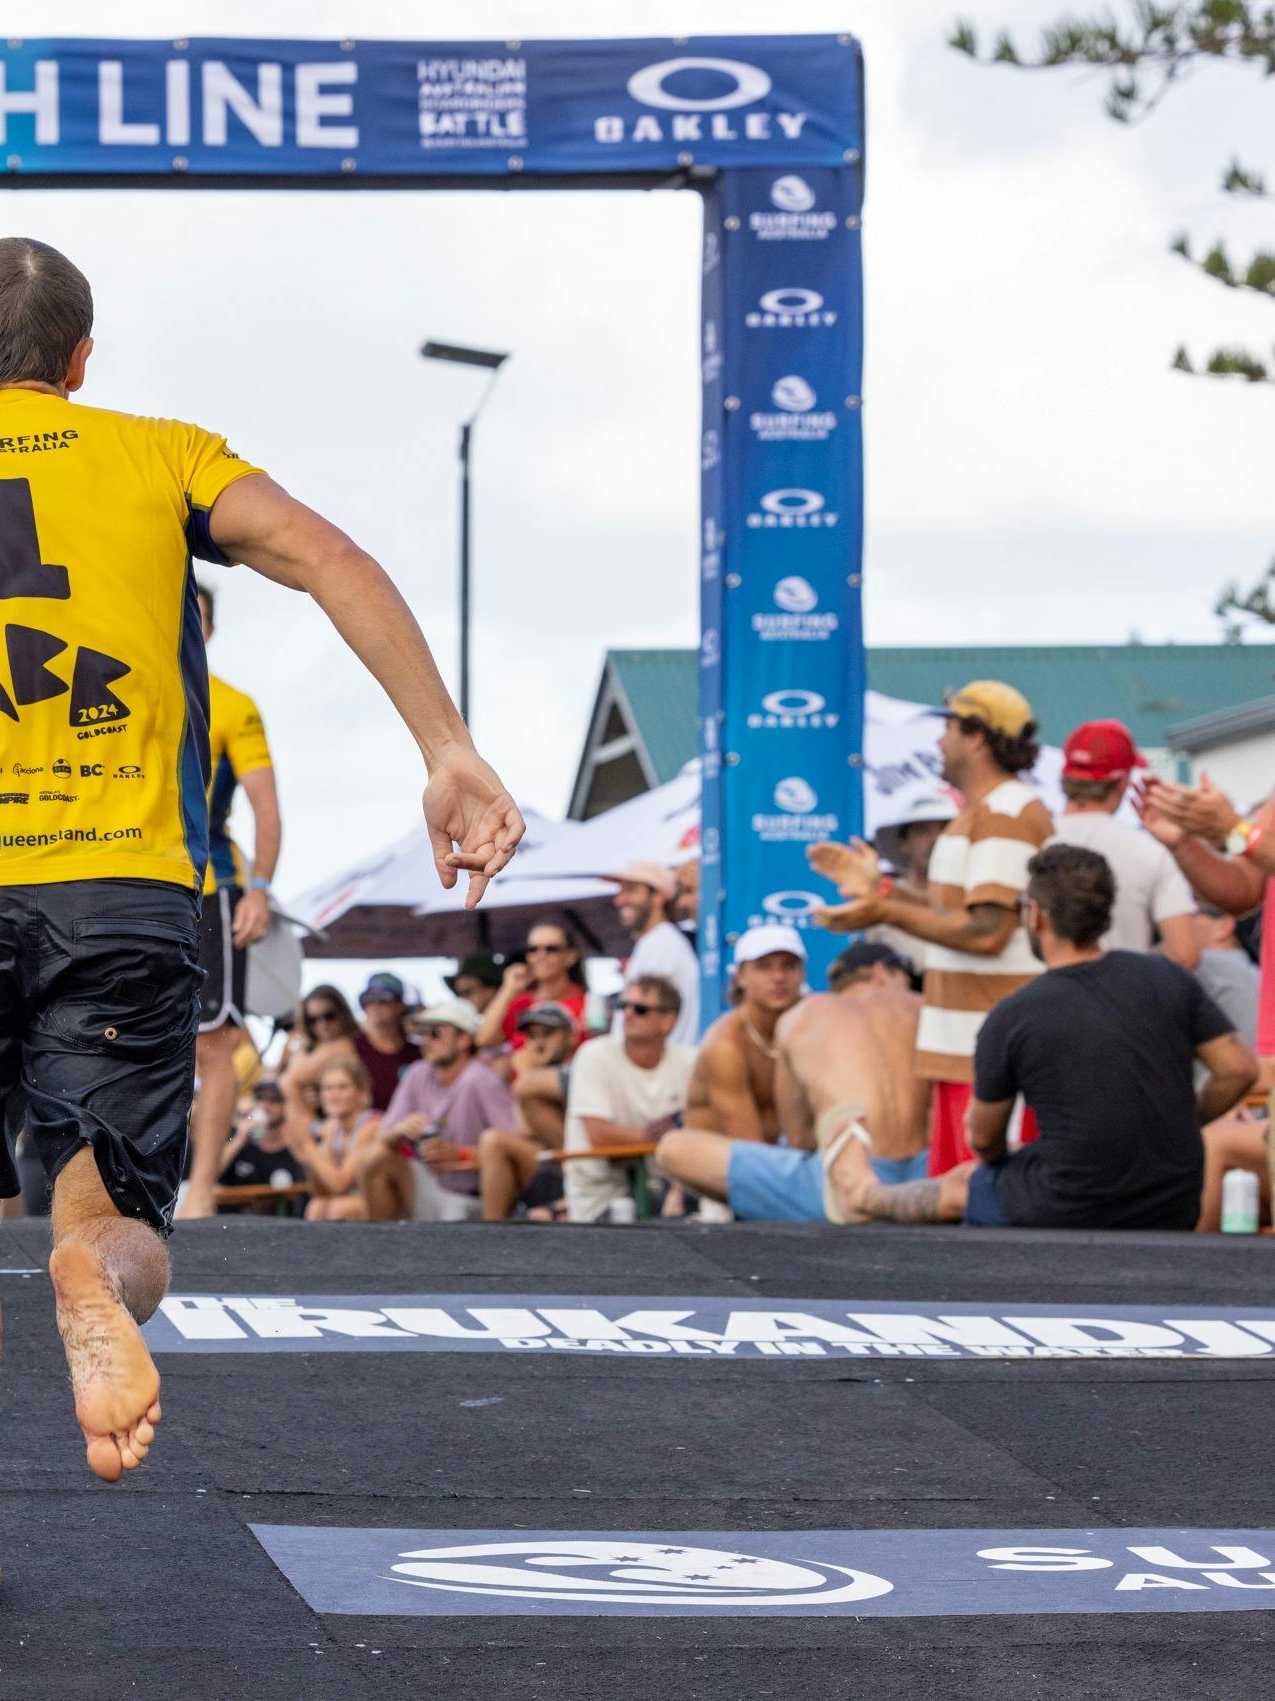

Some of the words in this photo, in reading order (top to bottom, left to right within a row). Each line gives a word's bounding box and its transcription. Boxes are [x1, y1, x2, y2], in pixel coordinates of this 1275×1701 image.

[417, 58, 526, 82] HYUNDAI
[99, 59, 359, 149] LINE
[419, 110, 527, 136] BATTLE
[594, 111, 809, 144] OAKLEY
[749, 210, 836, 231] SURFING
[745, 312, 837, 328] OAKLEY
[749, 411, 838, 431] SURFING
[746, 512, 839, 529] OAKLEY
[751, 612, 839, 632] SURFING
[77, 703, 119, 723] 2024
[746, 713, 840, 730] OAKLEY
[79, 764, 104, 778] BC
[751, 813, 839, 832] SURFING
[498, 1336, 740, 1355] DEADLY
[754, 1340, 827, 1356] IN
[830, 1342, 962, 1357] THE
